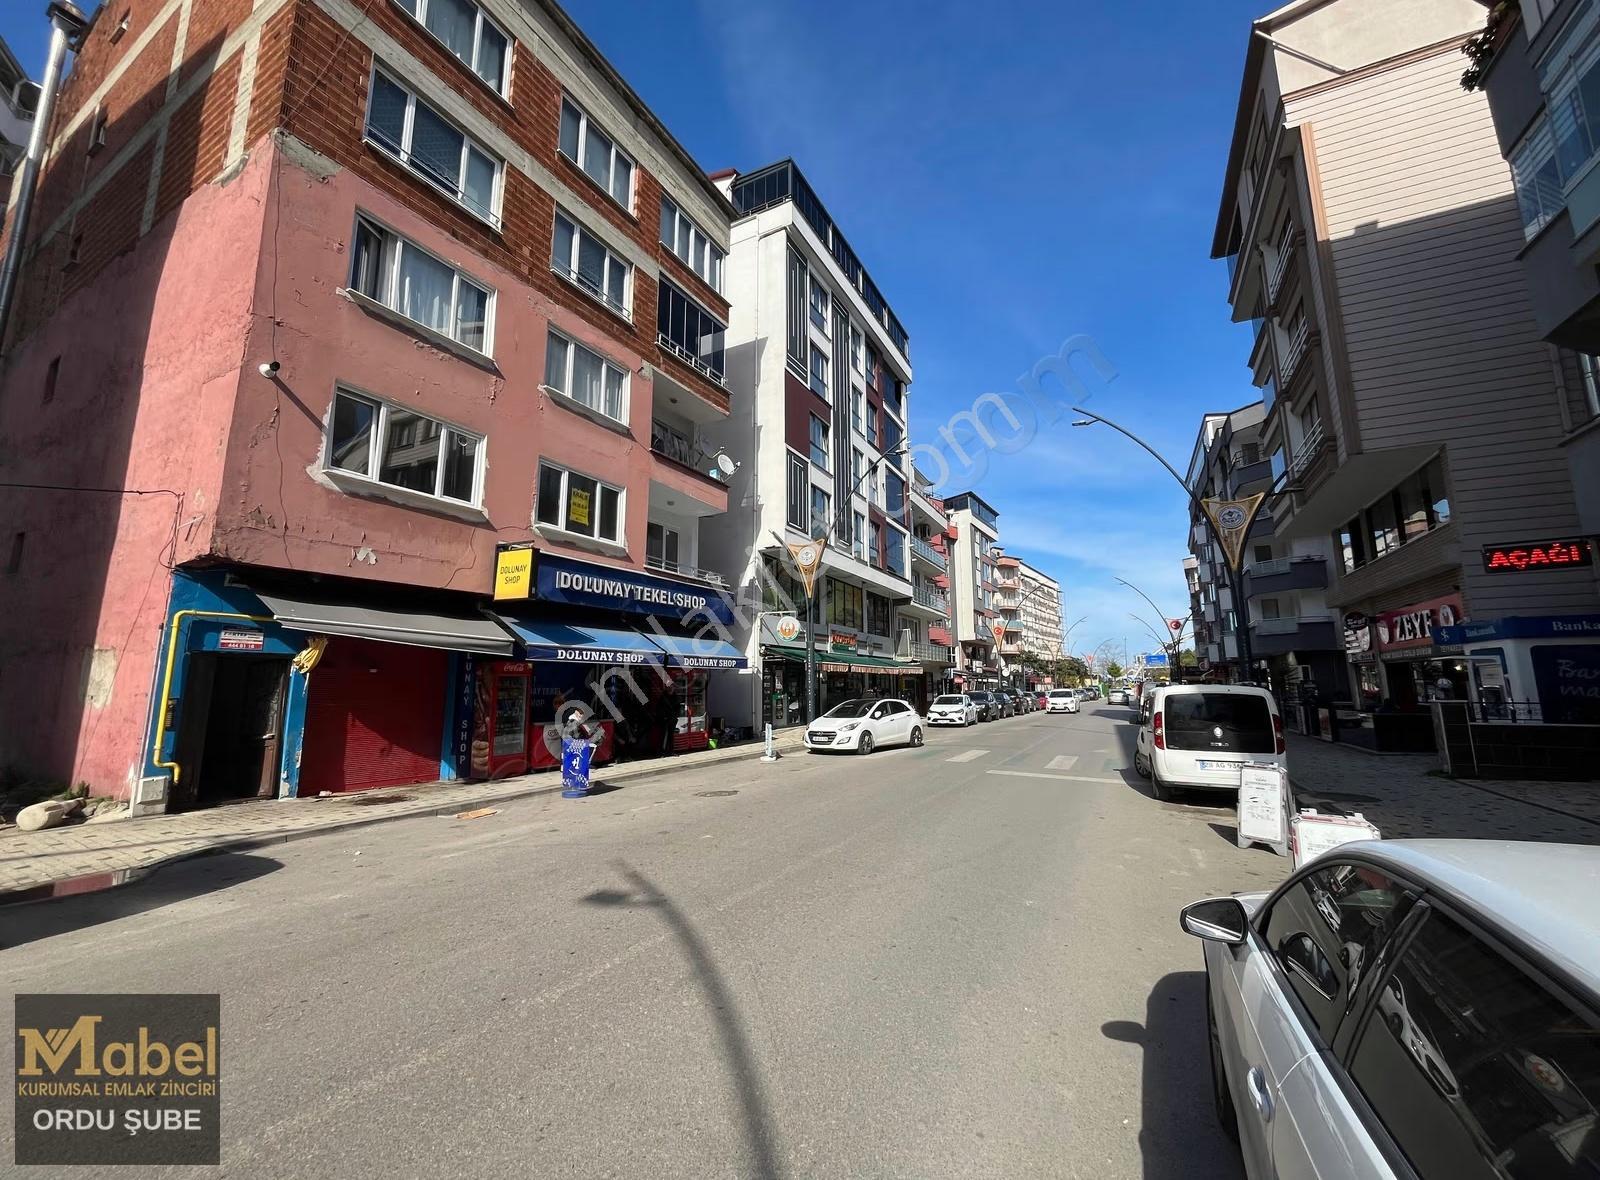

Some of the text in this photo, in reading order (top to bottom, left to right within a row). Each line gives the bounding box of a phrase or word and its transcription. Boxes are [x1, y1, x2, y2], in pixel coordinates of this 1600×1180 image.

[499, 564, 528, 574] DOLUNAY
[504, 576, 520, 585] SHOP
[558, 571, 706, 609] DOLUNAY TEKEL SHOP
[557, 649, 644, 663] DOLUNAY SHOP
[684, 657, 718, 666] DOLUNAY
